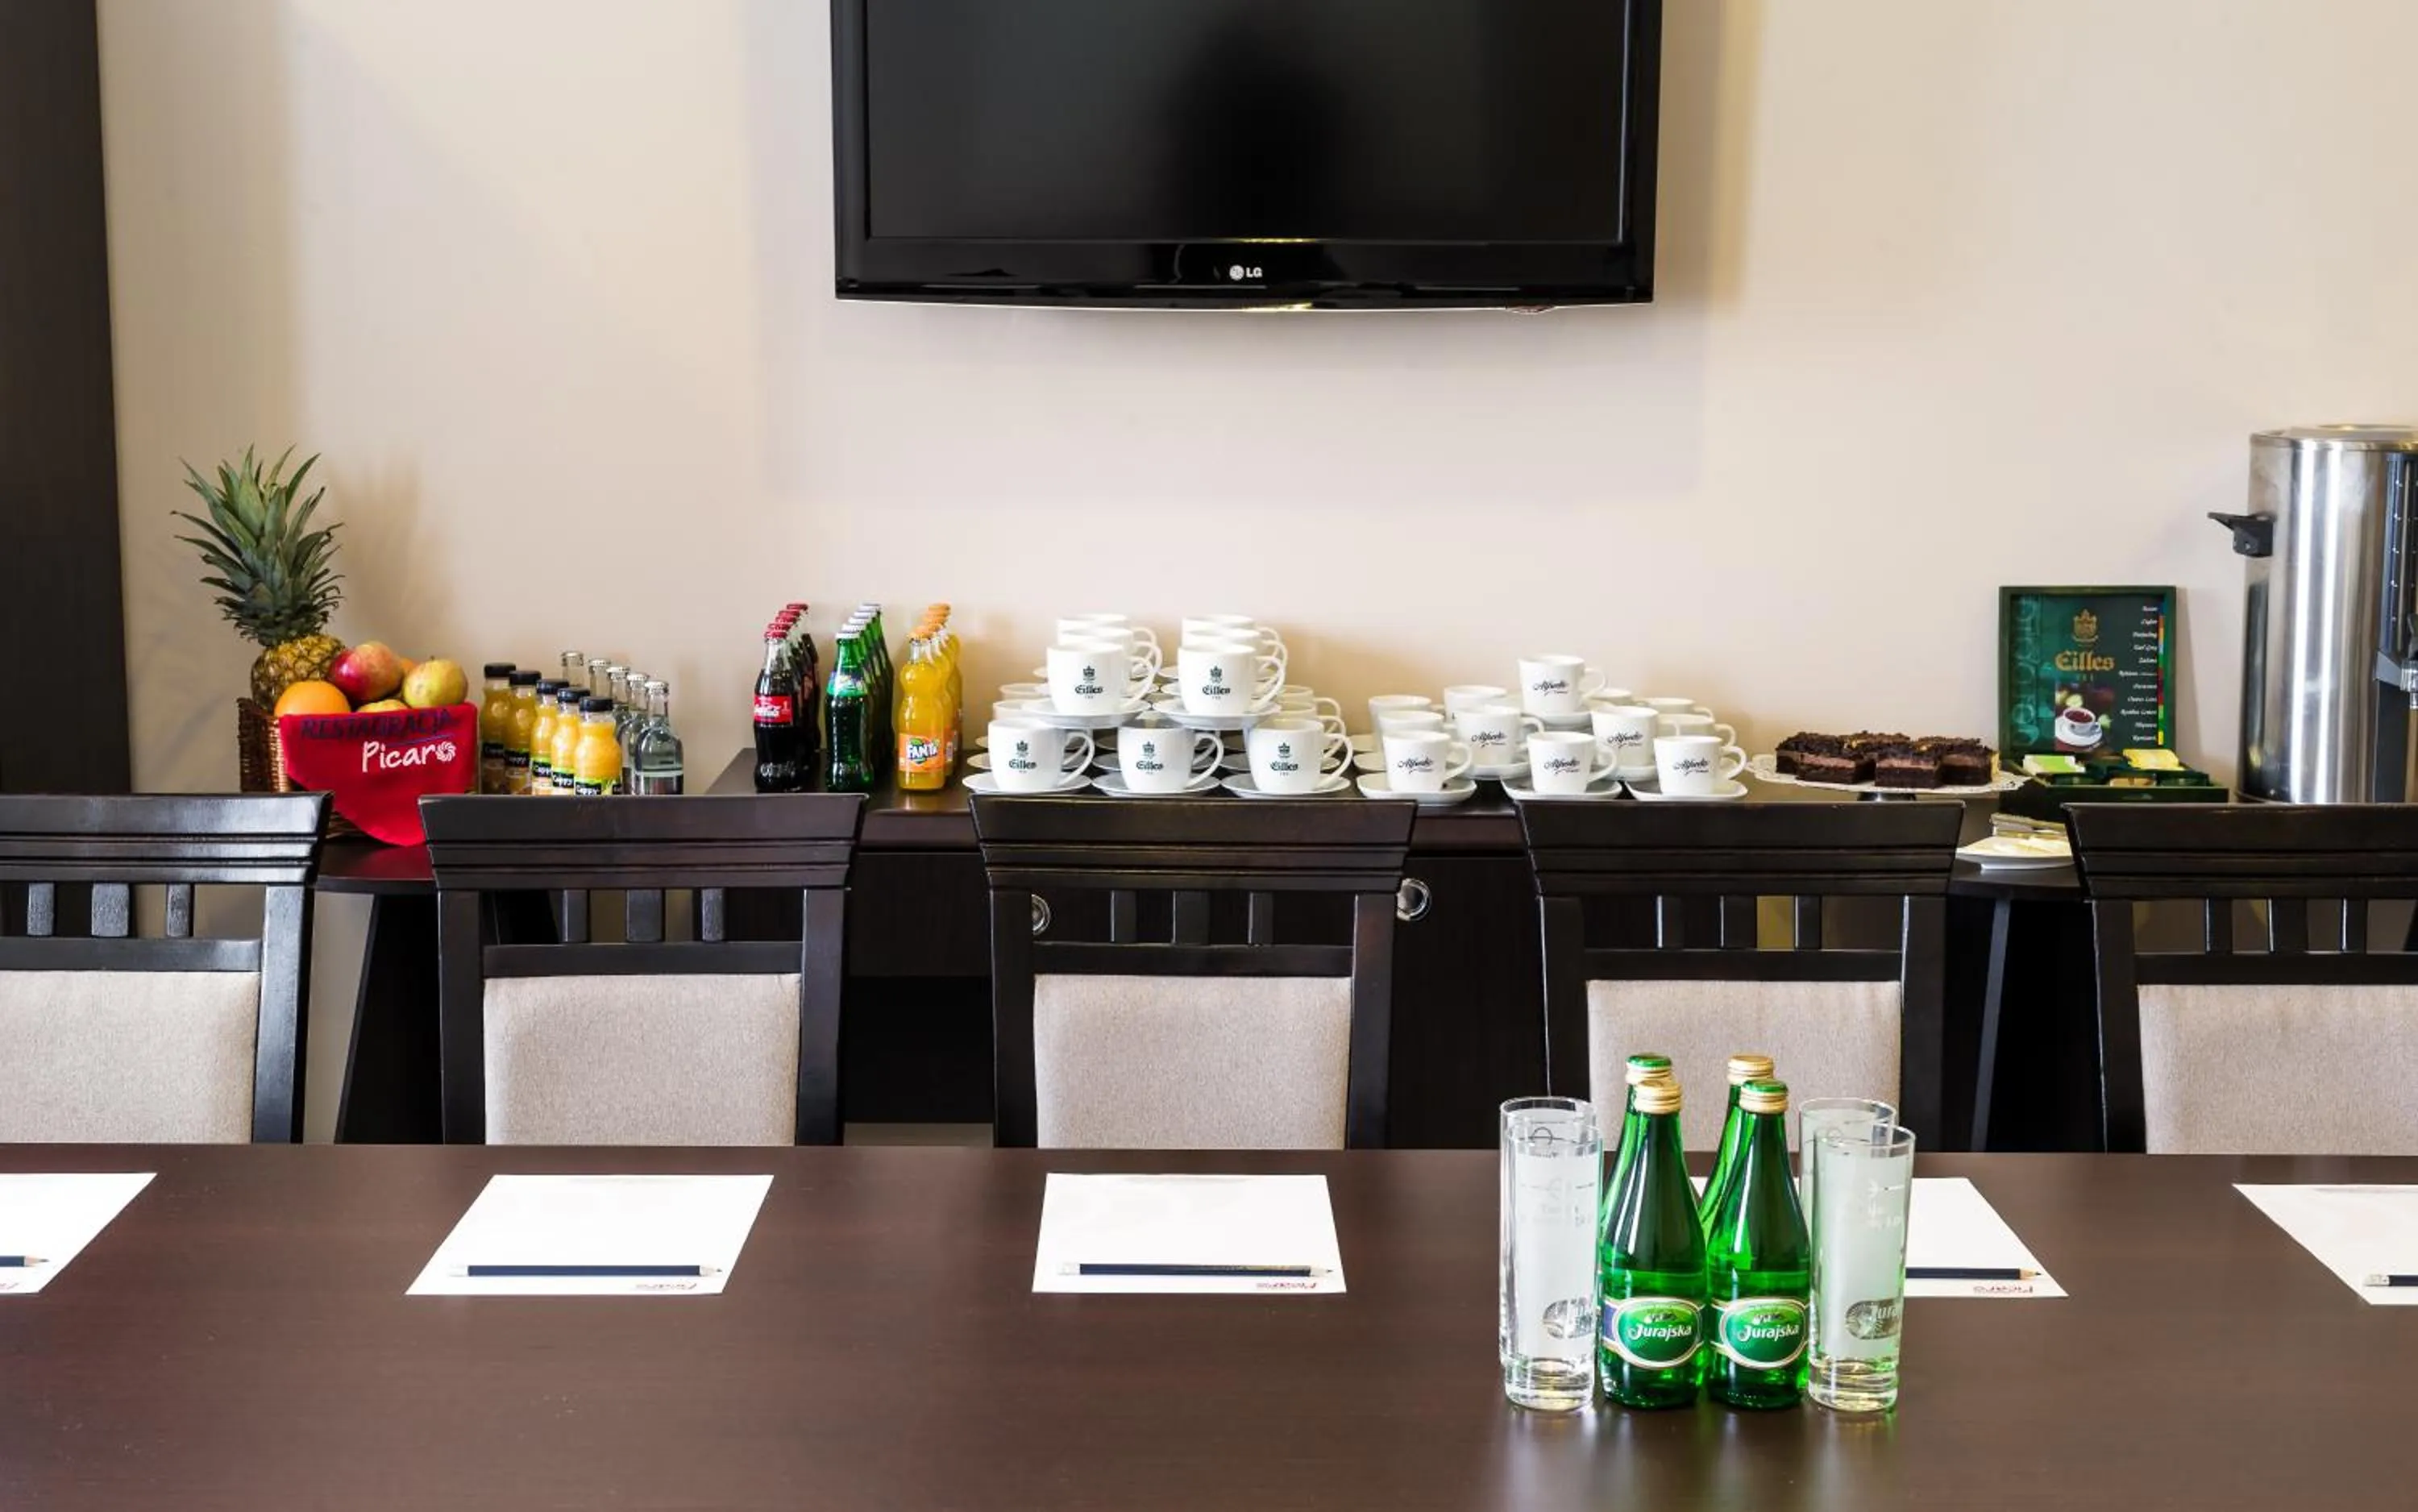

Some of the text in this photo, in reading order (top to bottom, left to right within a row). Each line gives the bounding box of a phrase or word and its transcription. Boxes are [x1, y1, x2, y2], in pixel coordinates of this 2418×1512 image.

[1245, 267, 1263, 278] LG
[2054, 650, 2115, 671] Eilles
[1627, 1323, 1692, 1342] Jurajska
[1737, 1323, 1799, 1341] Jurajska
